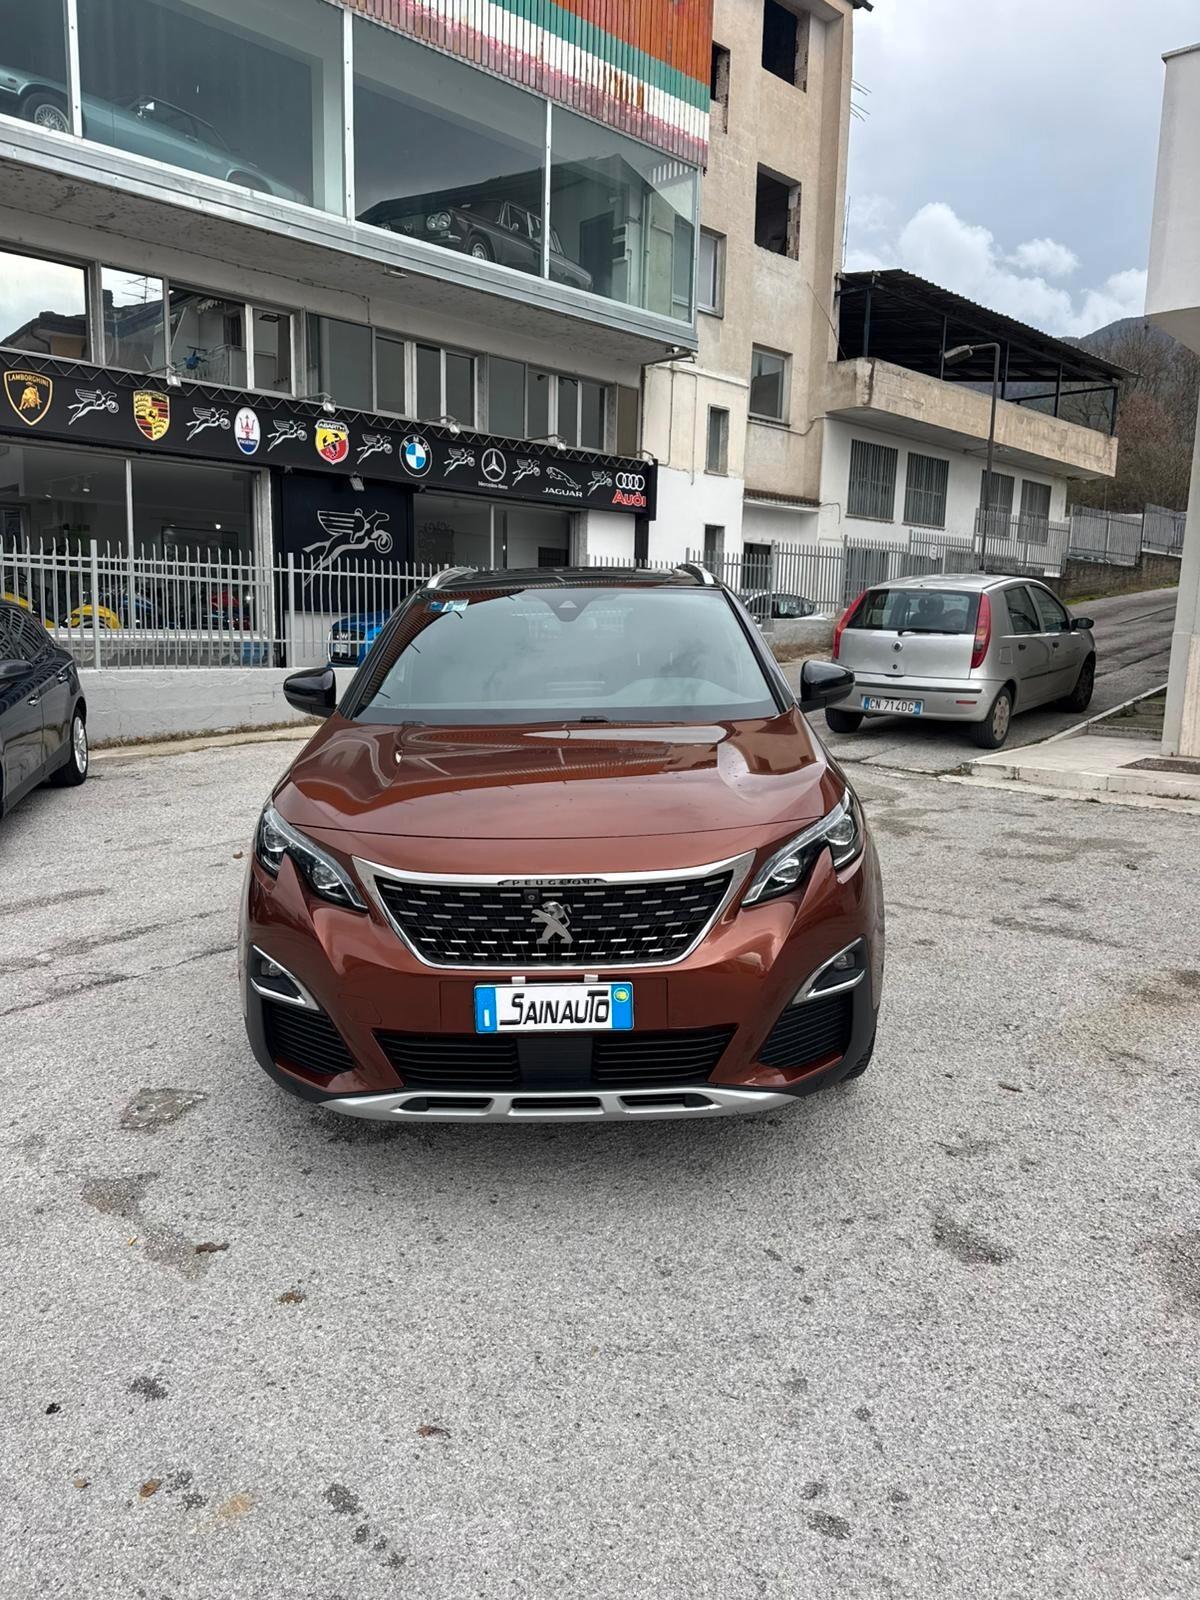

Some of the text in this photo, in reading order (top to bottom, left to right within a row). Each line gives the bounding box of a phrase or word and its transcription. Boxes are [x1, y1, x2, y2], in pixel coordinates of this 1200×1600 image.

[403, 436, 430, 451] BMW
[542, 487, 583, 498] JAGUAR
[612, 489, 647, 508] Audi
[870, 698, 881, 709] CN
